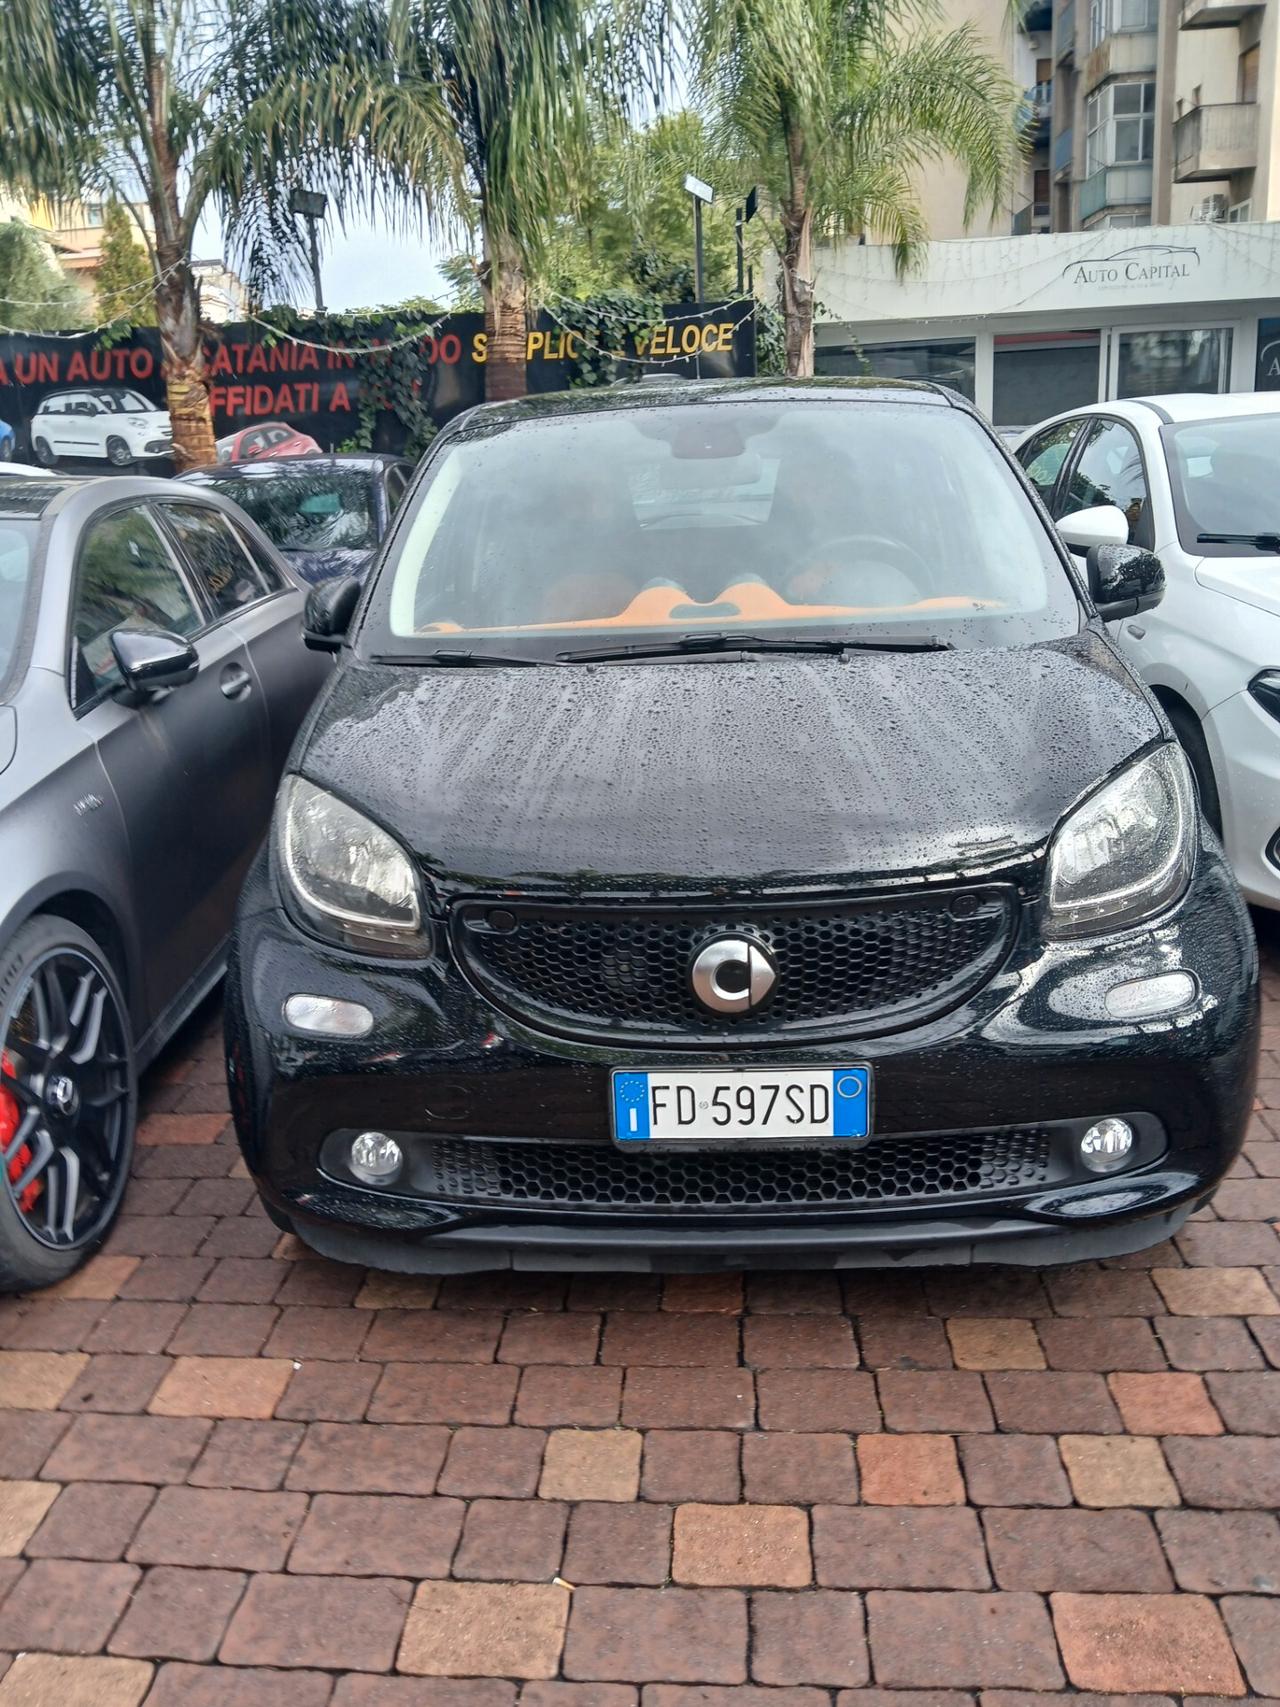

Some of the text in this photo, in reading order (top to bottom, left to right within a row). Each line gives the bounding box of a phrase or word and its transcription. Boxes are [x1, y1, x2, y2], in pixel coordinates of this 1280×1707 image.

[15, 352, 59, 384] UN
[67, 348, 153, 381] AUTO
[327, 340, 353, 368] IN
[472, 330, 600, 363] SPLIC
[209, 382, 320, 416] FFIDATI
[329, 382, 351, 412] A
[651, 1083, 829, 1126] FD 597SD
